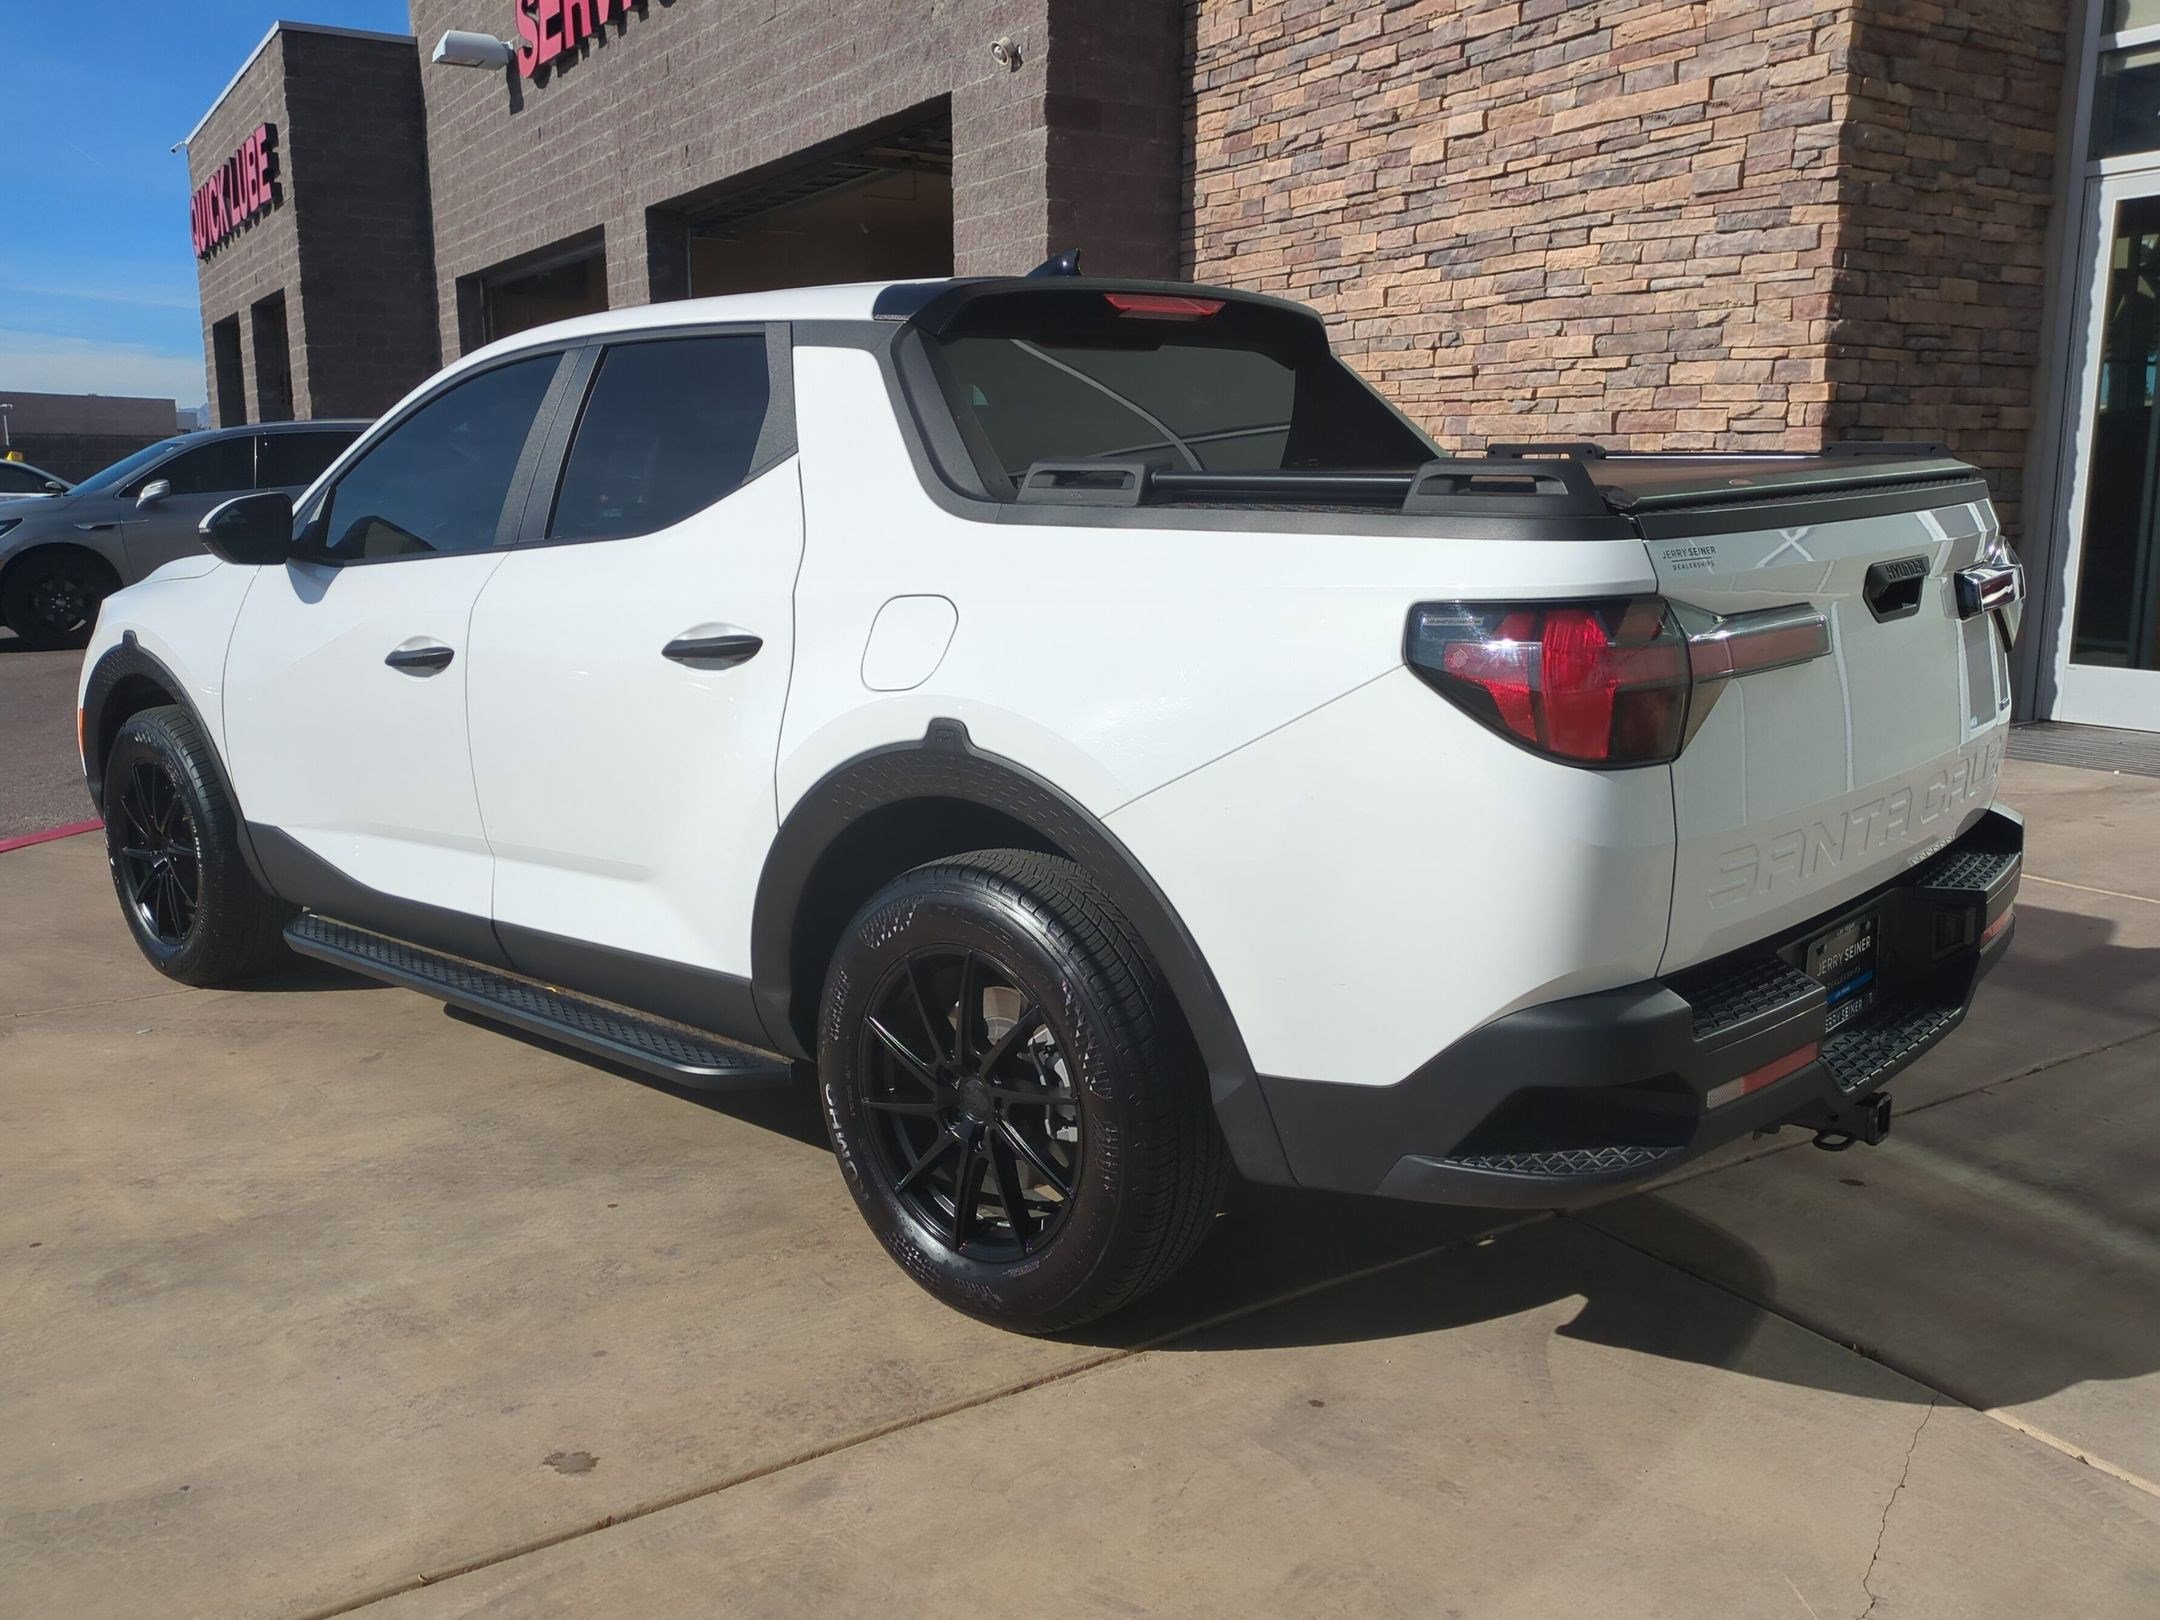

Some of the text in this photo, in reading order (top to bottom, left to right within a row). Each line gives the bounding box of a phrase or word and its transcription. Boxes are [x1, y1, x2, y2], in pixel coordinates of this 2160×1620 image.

[515, 0, 632, 78] SER
[190, 122, 272, 259] QUICK LUBE
[1663, 546, 1716, 559] JERRY SEINER
[1672, 560, 1715, 571] DEALERSHIPS
[1886, 559, 1927, 580] HYUNDAI
[1708, 786, 1914, 911] SANTA
[1817, 936, 1871, 977] JERRY SEINER
[1825, 1010, 1841, 1031] ERRY
